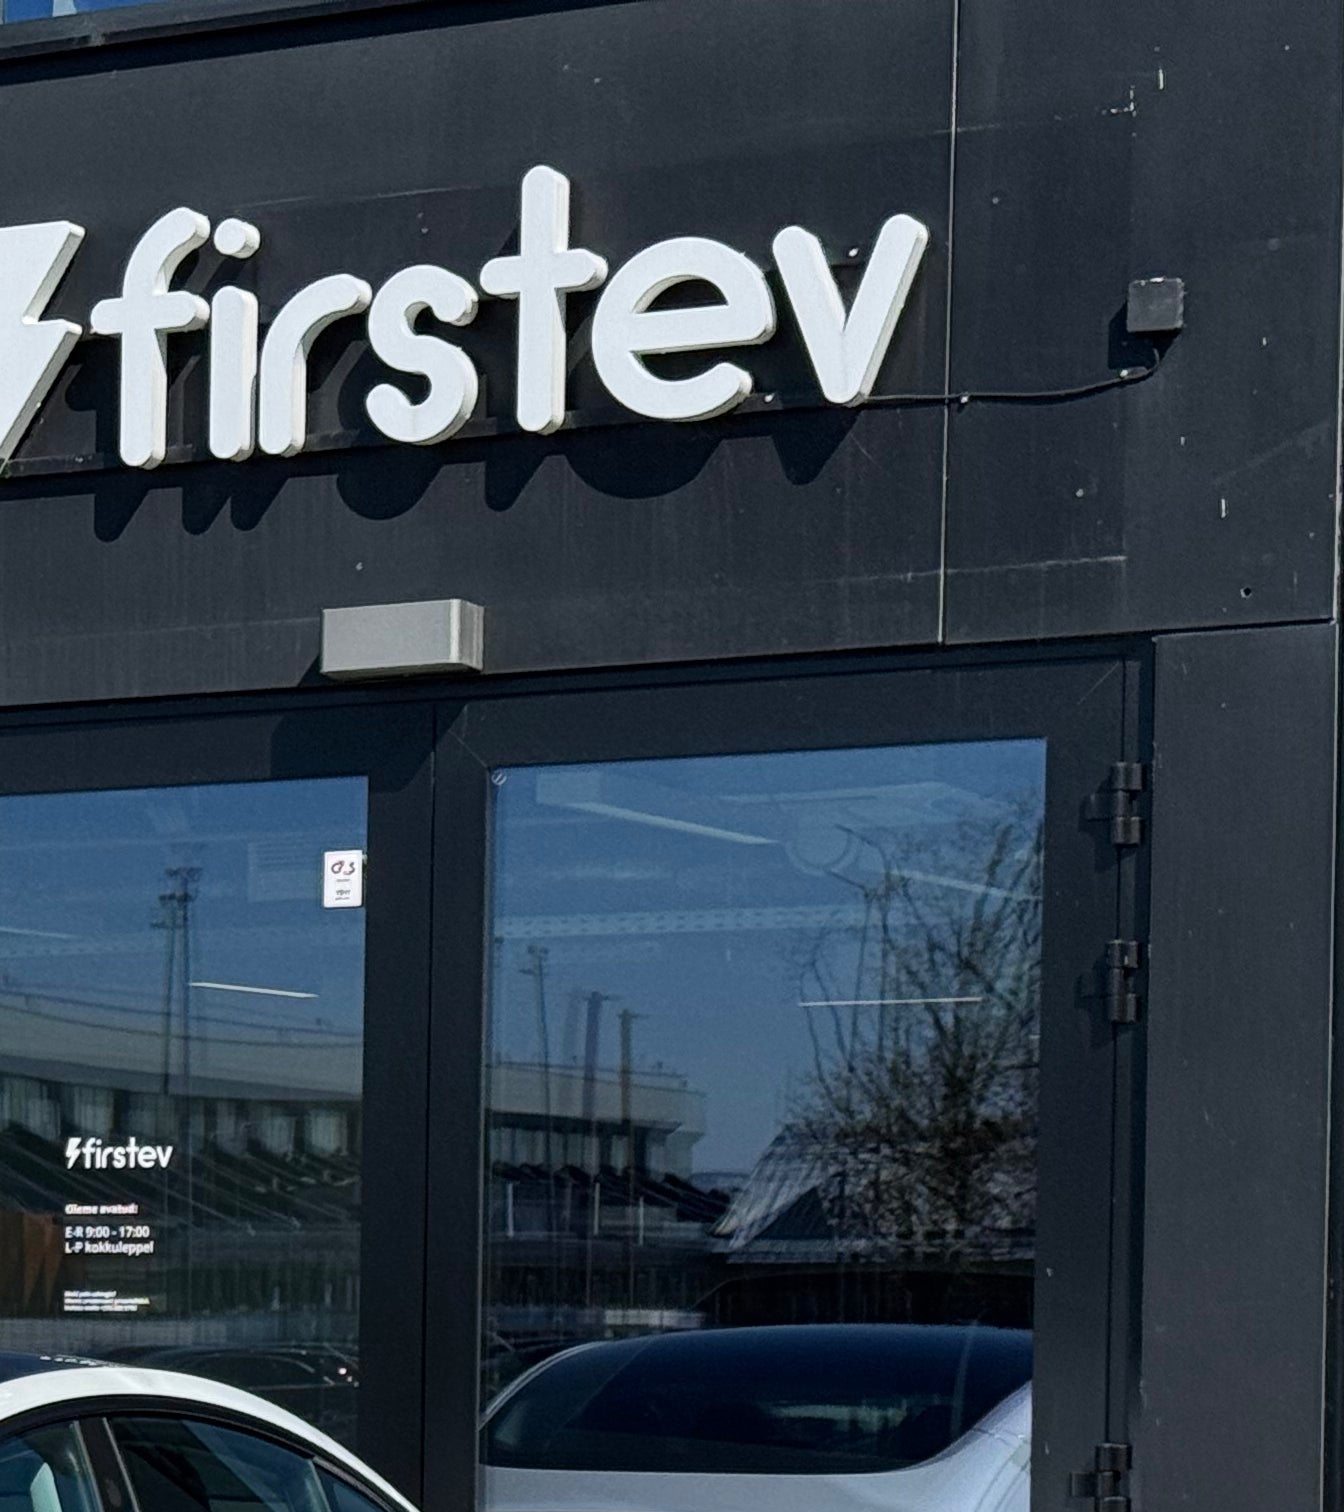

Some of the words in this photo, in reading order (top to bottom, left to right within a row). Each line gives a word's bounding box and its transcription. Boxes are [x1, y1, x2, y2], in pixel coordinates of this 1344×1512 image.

[90, 164, 928, 468] firstev
[82, 1137, 173, 1168] firstev
[85, 1225, 109, 1238] 9:00
[119, 1225, 149, 1238] 17:00
